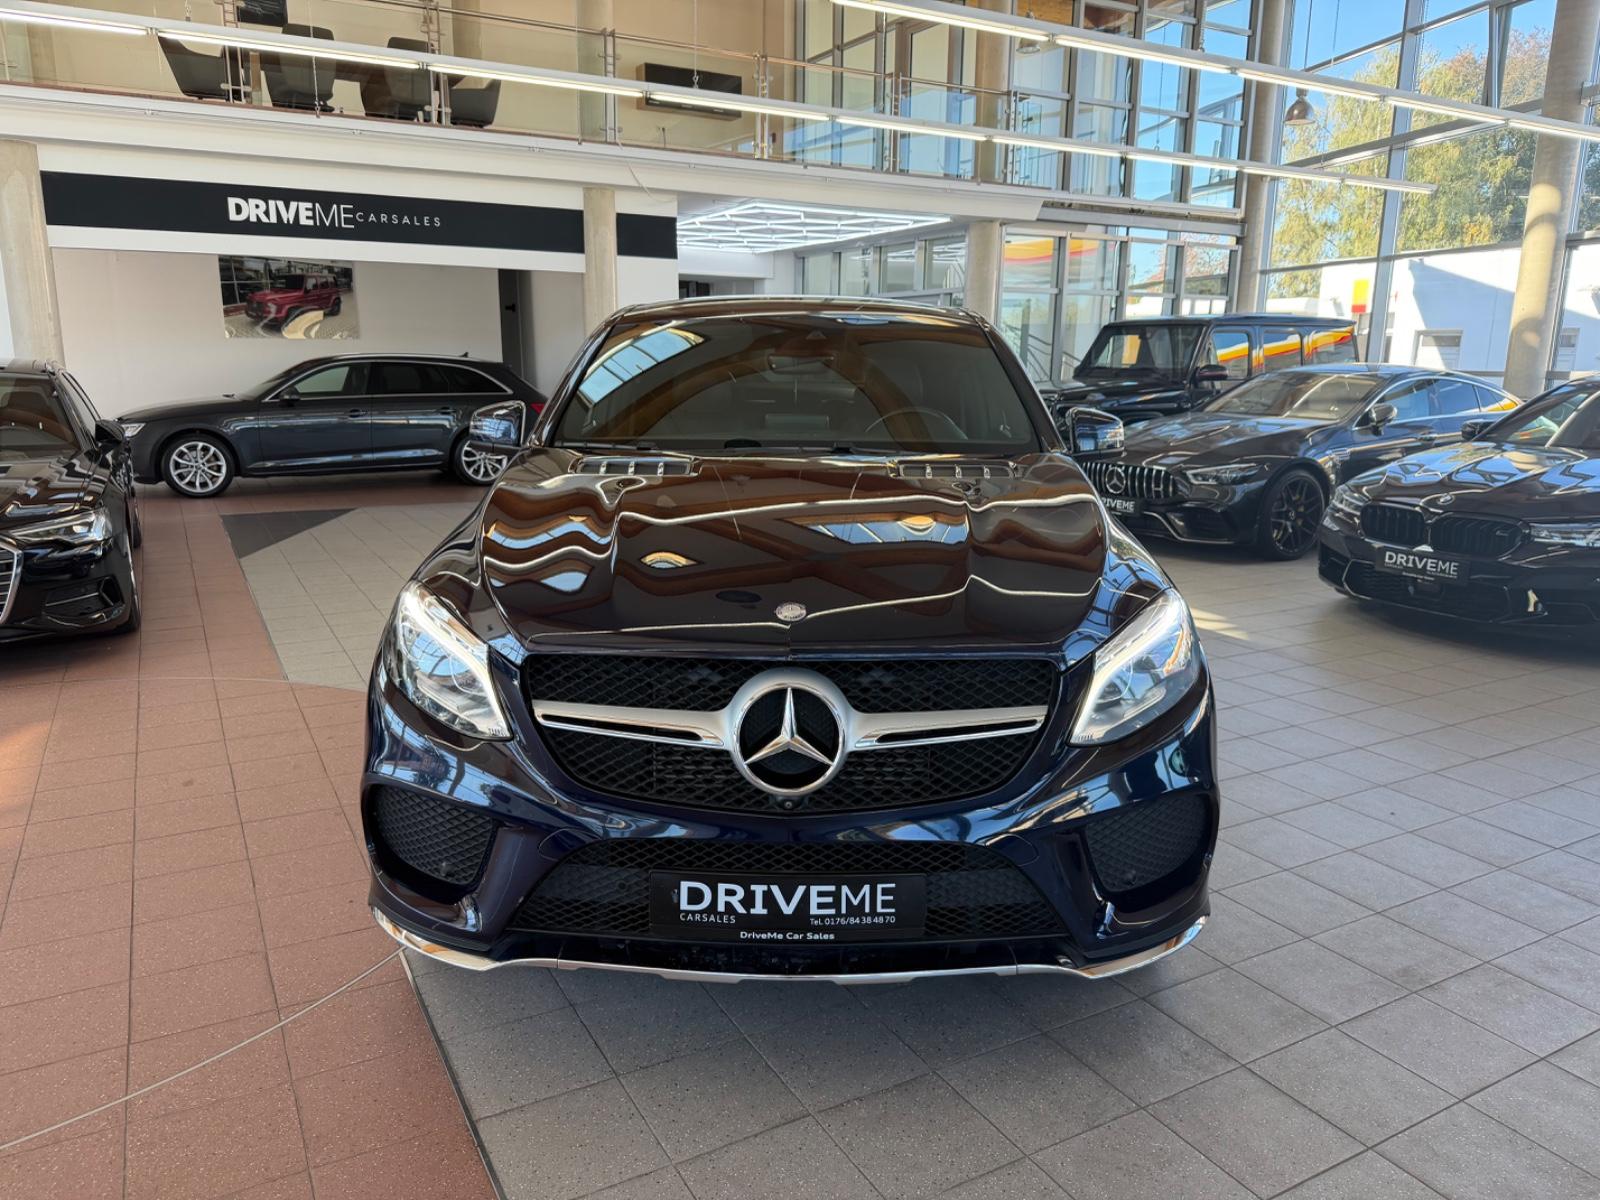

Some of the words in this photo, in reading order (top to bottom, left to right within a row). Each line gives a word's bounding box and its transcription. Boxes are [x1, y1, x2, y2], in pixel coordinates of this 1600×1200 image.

[227, 197, 355, 229] DRIVEME
[355, 212, 441, 227] CARSALES
[1385, 551, 1459, 576] DRIVEME
[680, 881, 896, 915] DRIVEME
[679, 913, 736, 924] CARSALES
[739, 931, 784, 940] DriveMe
[785, 931, 804, 940] Car
[806, 932, 835, 940] Sales
